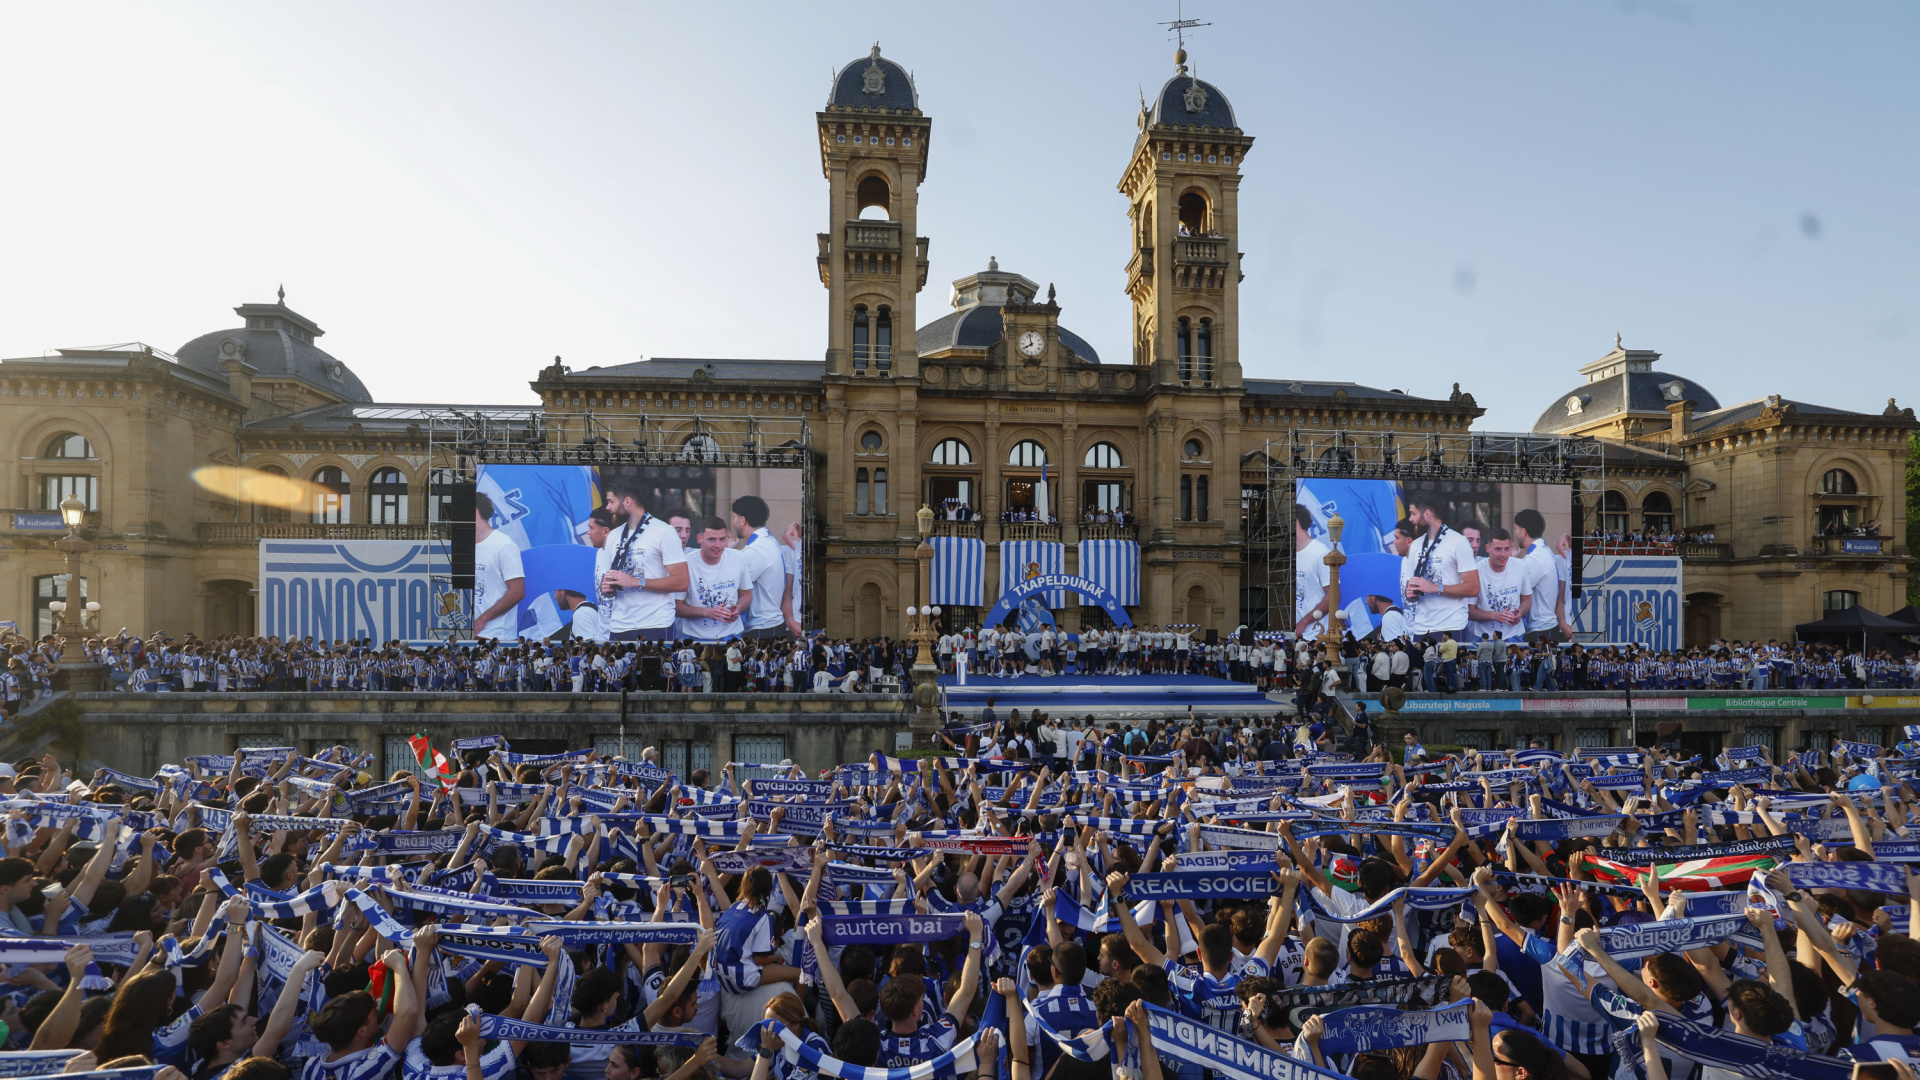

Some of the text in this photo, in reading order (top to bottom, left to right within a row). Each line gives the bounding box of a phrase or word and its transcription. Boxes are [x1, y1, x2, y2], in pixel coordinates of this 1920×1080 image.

[27, 519, 62, 527] kutxabank
[1013, 575, 1105, 599] TXAPELDUNAK
[1404, 700, 1490, 711] Liburutegi Nagusia
[1550, 698, 1659, 709] Biblioteca Municipa Central
[1725, 698, 1808, 708] Bibliothèque Centrale
[1897, 697, 1917, 705] Main
[613, 761, 630, 774] EAL
[631, 765, 668, 780] SOCIEDA
[755, 781, 833, 793] EAL SOCIEDAD
[1425, 779, 1471, 789] SOCIED
[785, 809, 822, 823] SOCIED
[1522, 823, 1541, 834] beti
[508, 884, 573, 895] SOCIEDAD
[1130, 876, 1280, 895] REAL SOCIED
[835, 917, 943, 937] aurten bai
[441, 933, 543, 954] AL SOCIED
[1201, 994, 1242, 1010] OYARZAB
